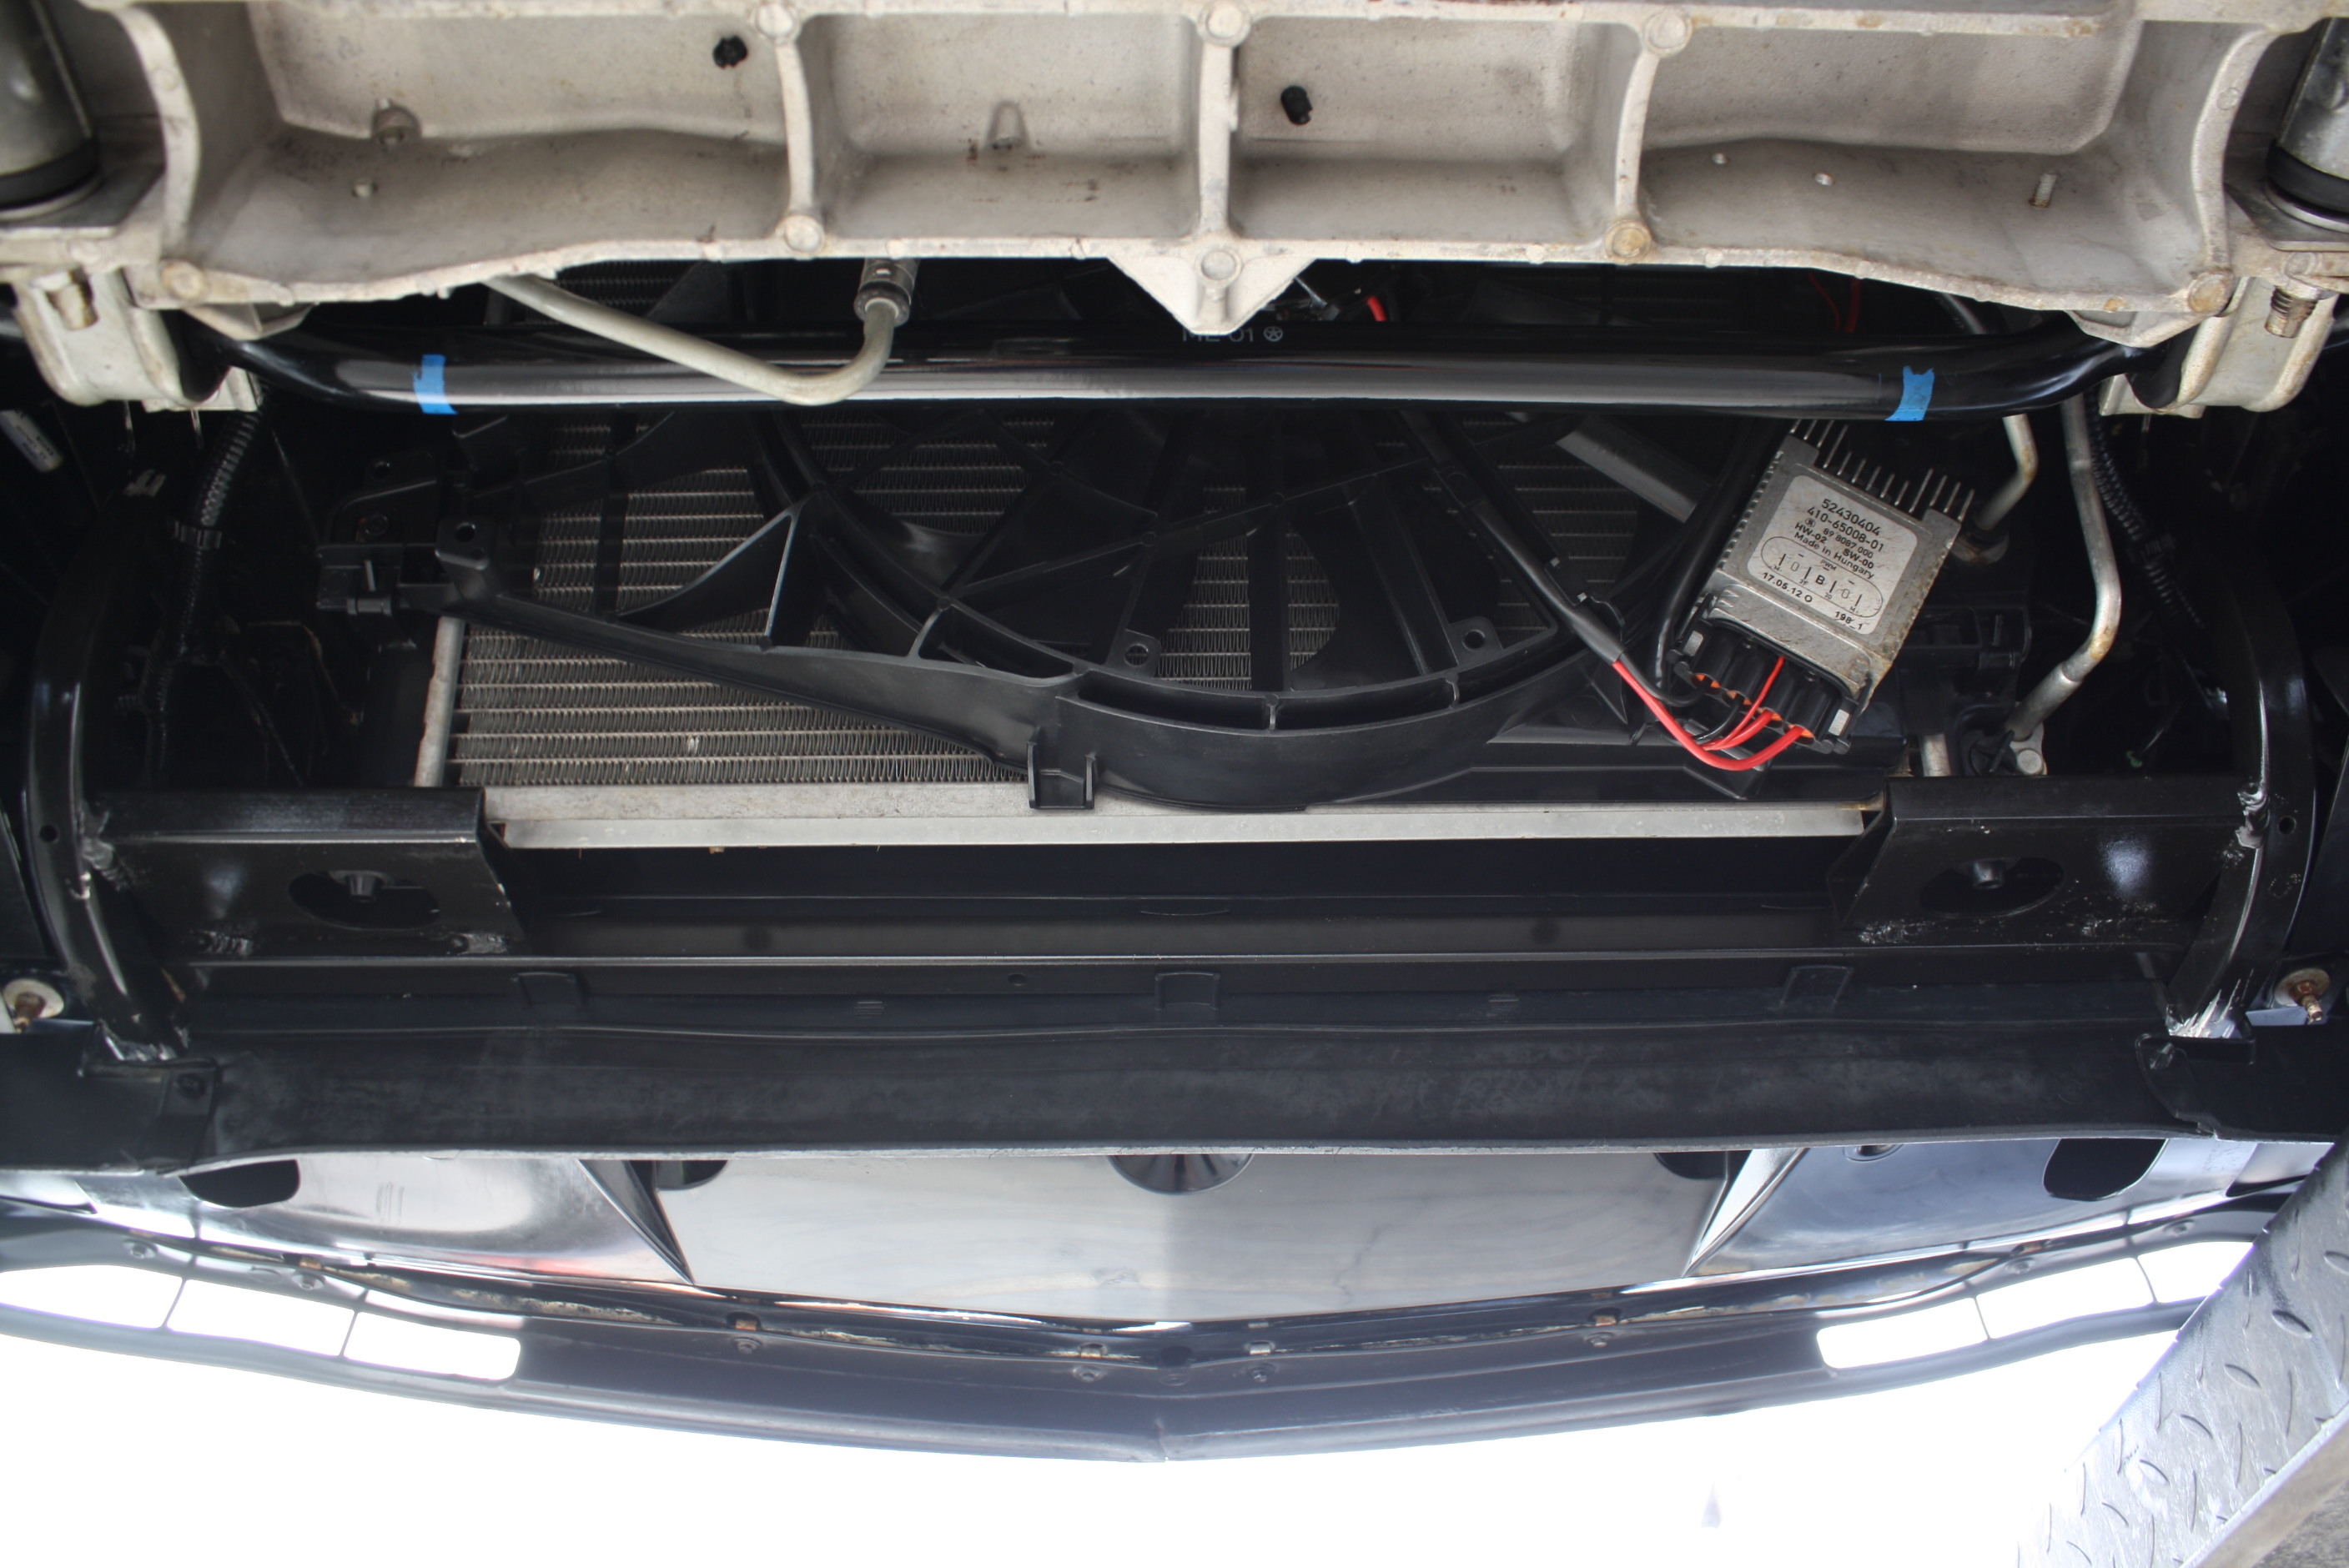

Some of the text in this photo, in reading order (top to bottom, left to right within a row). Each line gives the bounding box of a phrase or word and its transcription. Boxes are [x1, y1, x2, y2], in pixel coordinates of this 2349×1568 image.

[1807, 506, 1884, 552] 410-65008-01
[1822, 498, 1881, 536] 52430404
[1794, 522, 1874, 569] HW-02 SW-00
[1794, 531, 1875, 580] Made in Hungary
[1823, 528, 1874, 559] 89 8087 000
[1815, 575, 1826, 585] B
[1820, 559, 1837, 571] PWM
[1763, 572, 1803, 598] 17.05.12
